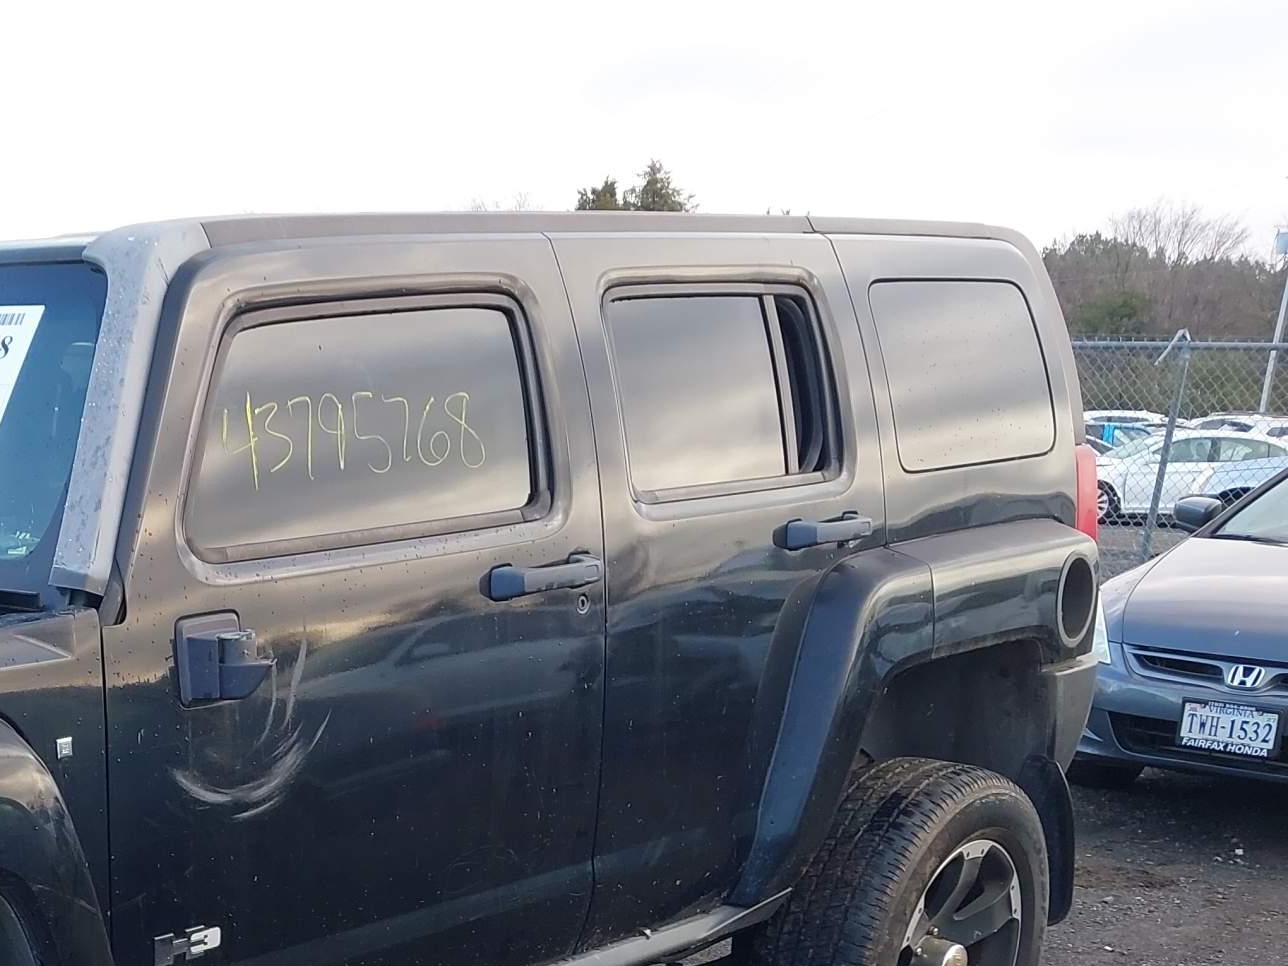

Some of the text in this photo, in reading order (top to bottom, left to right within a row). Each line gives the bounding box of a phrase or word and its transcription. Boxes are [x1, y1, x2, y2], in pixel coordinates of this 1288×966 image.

[223, 391, 485, 490] 43795768
[1208, 706, 1255, 718] VIRGINIA
[1187, 713, 1272, 743] TWH-1532
[1182, 737, 1268, 757] FAIRFAX HONDA
